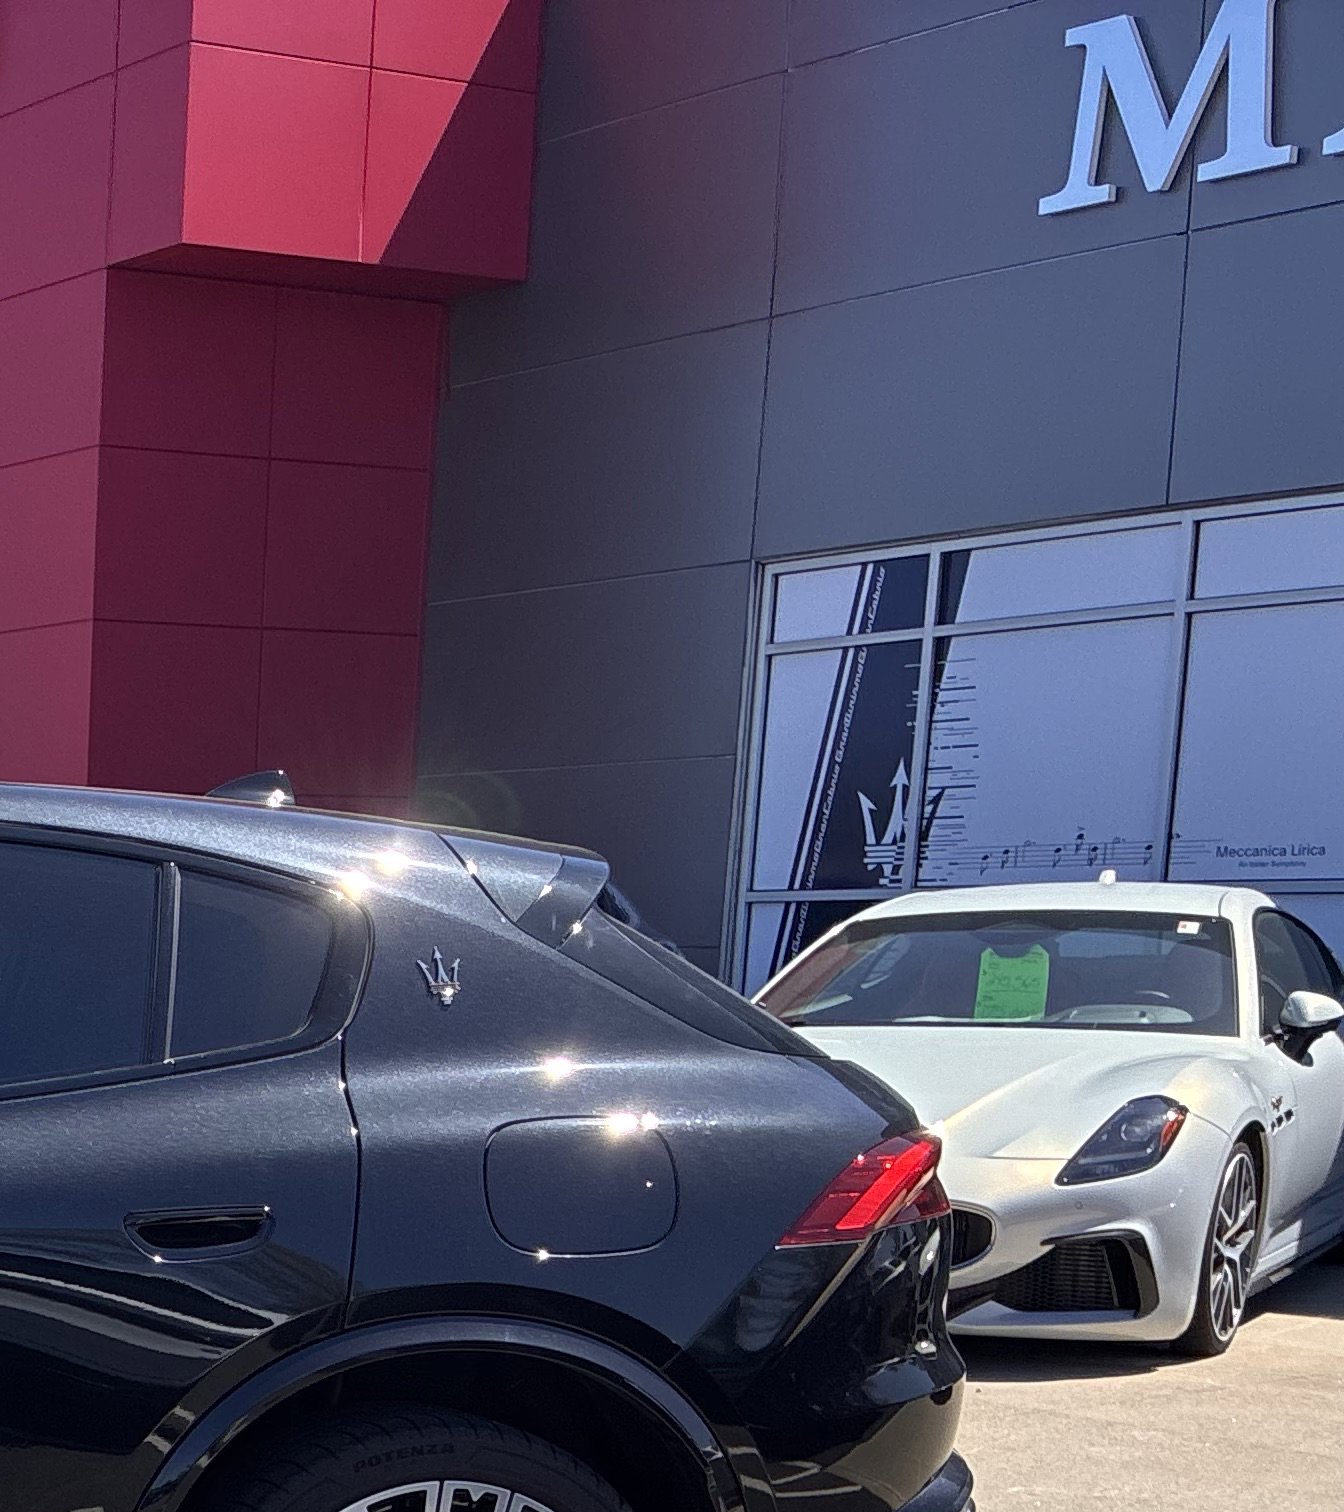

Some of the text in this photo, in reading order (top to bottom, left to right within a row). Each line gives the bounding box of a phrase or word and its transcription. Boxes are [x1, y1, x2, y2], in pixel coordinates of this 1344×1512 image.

[1215, 843, 1326, 858] Meccanica Lirica
[353, 1442, 456, 1473] POTENZA
